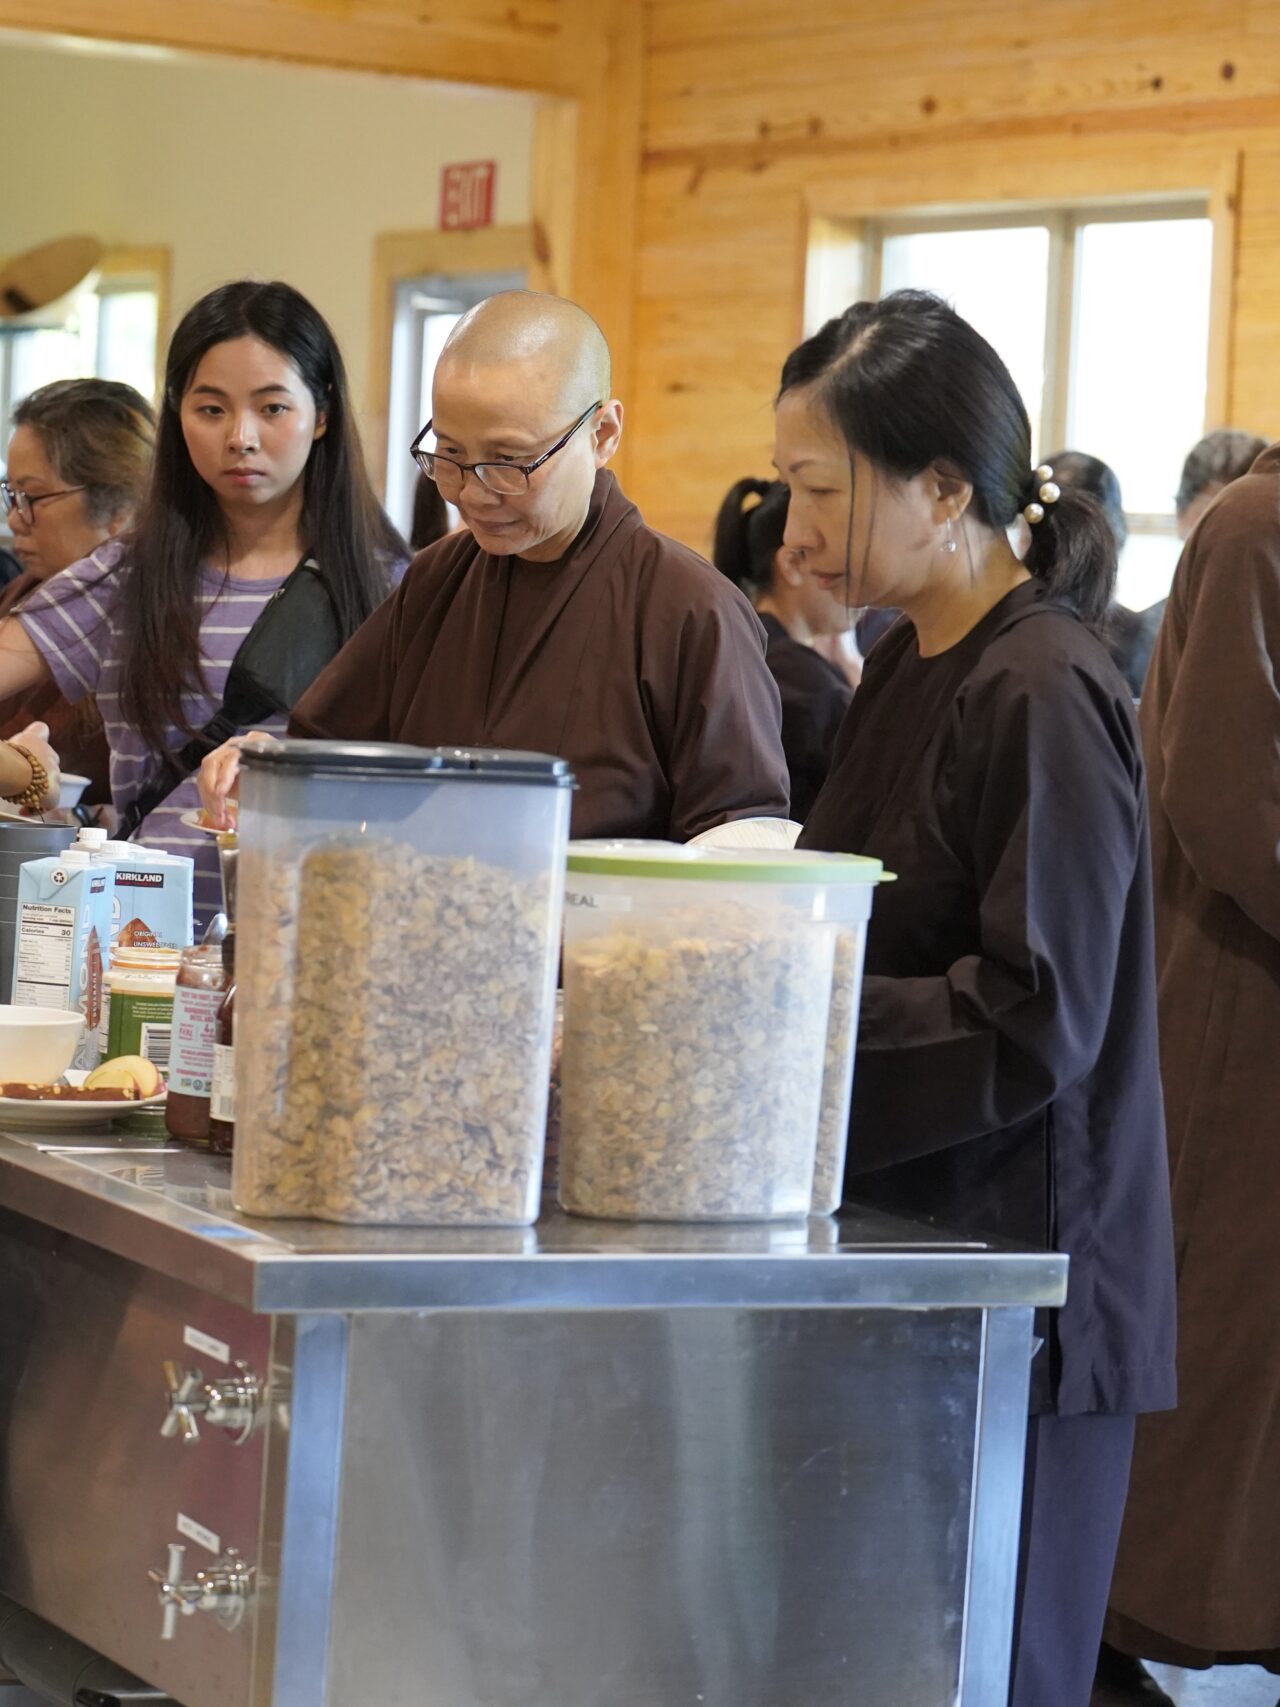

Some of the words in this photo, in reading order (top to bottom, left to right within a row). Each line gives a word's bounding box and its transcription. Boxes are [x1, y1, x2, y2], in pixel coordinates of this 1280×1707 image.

[446, 164, 488, 225] EXIT
[116, 872, 163, 883] KIRKLAND
[22, 904, 52, 912] Nutrition
[53, 906, 72, 914] Facts
[60, 929, 71, 937] 30
